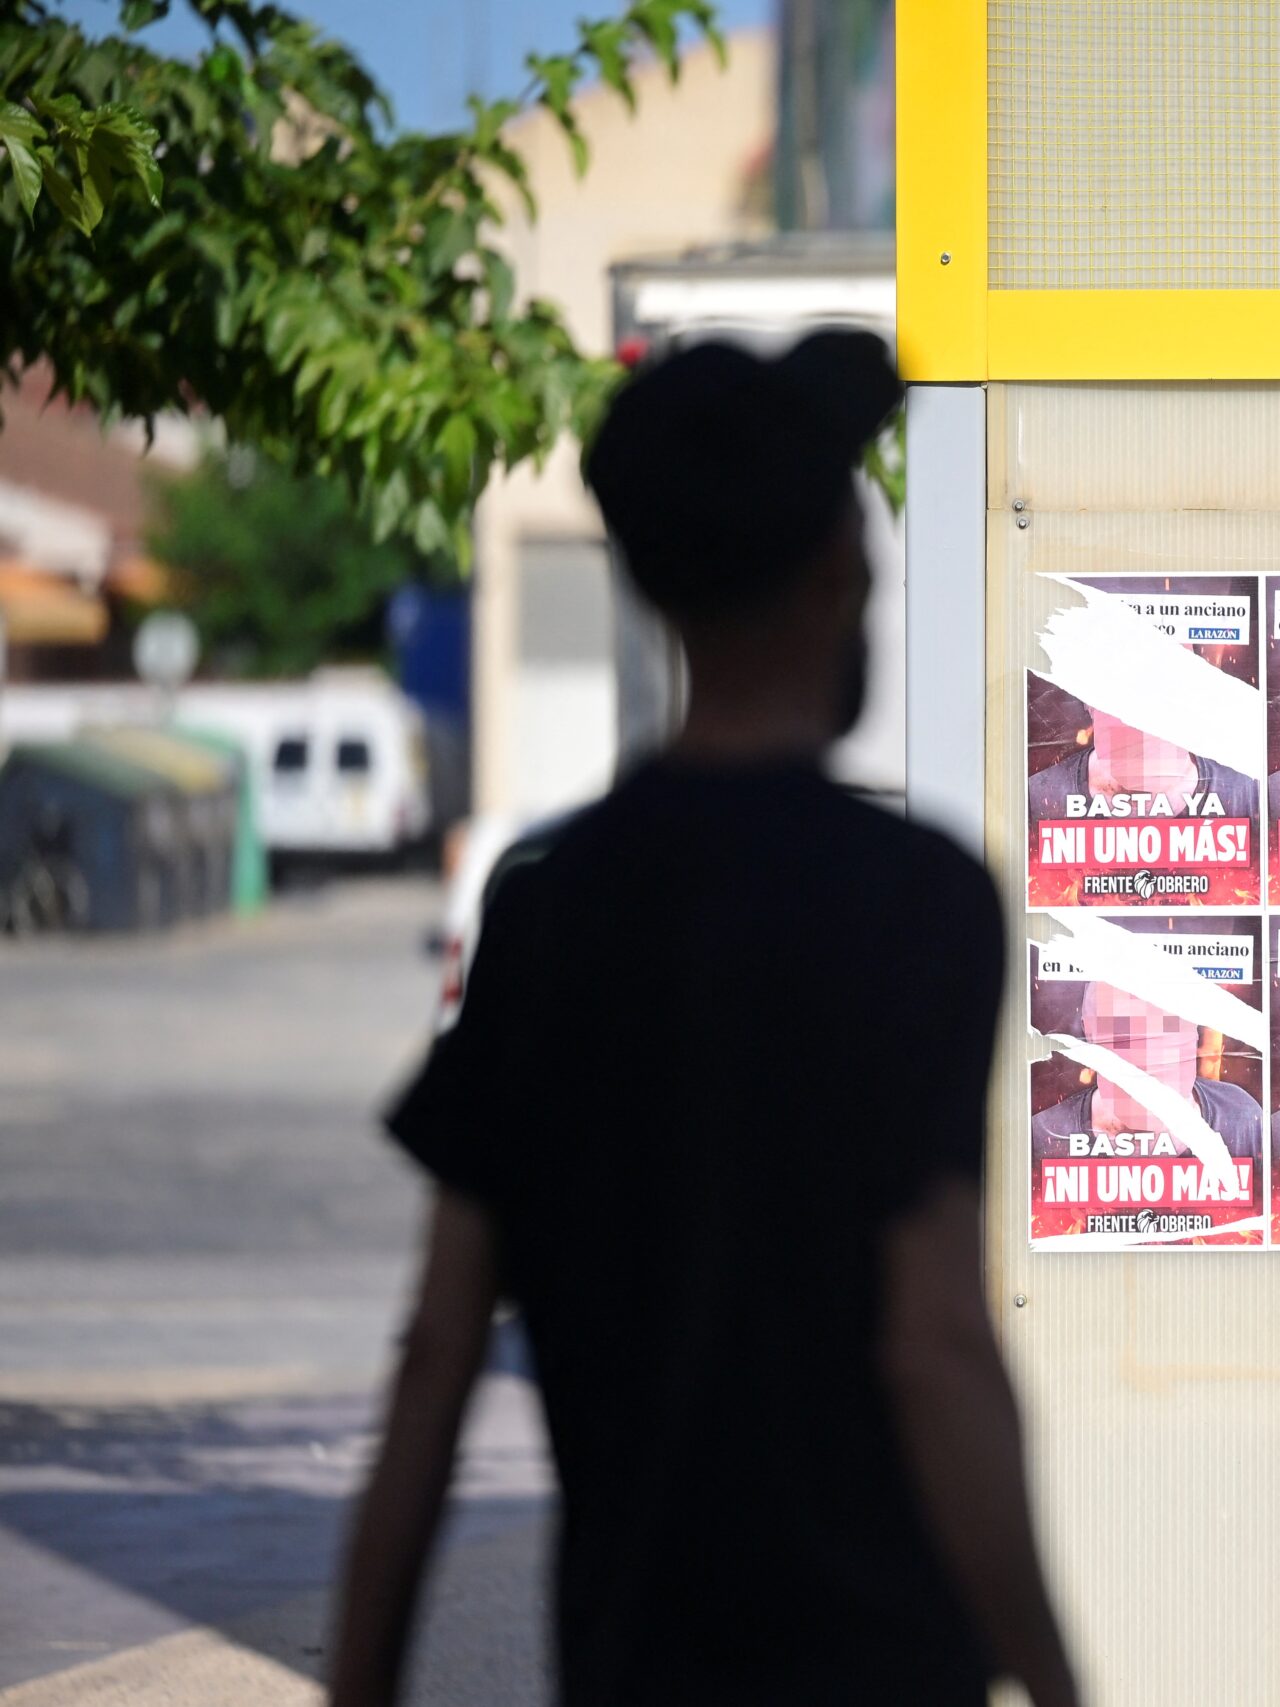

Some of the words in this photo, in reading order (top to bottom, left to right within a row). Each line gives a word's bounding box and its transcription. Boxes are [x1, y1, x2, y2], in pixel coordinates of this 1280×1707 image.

[1146, 604, 1155, 614] a
[1159, 605, 1180, 615] un
[1184, 602, 1246, 617] anciano
[1066, 793, 1173, 817] BASTA
[1182, 792, 1225, 816] YA
[1041, 828, 1085, 863] ¡NI
[1094, 826, 1161, 863] UNO
[1169, 820, 1247, 862] MÁS!
[1084, 876, 1133, 894] FRENTE
[1157, 876, 1208, 893] OBRERO
[1163, 944, 1182, 955] un
[1188, 942, 1249, 957] anciano
[1043, 961, 1061, 972] en
[1069, 1132, 1177, 1157] BASTA
[1045, 1166, 1088, 1202] ¡NI
[1097, 1165, 1165, 1202] UNO
[1087, 1216, 1136, 1232] FRENTE
[1160, 1215, 1211, 1232] OBRERO
